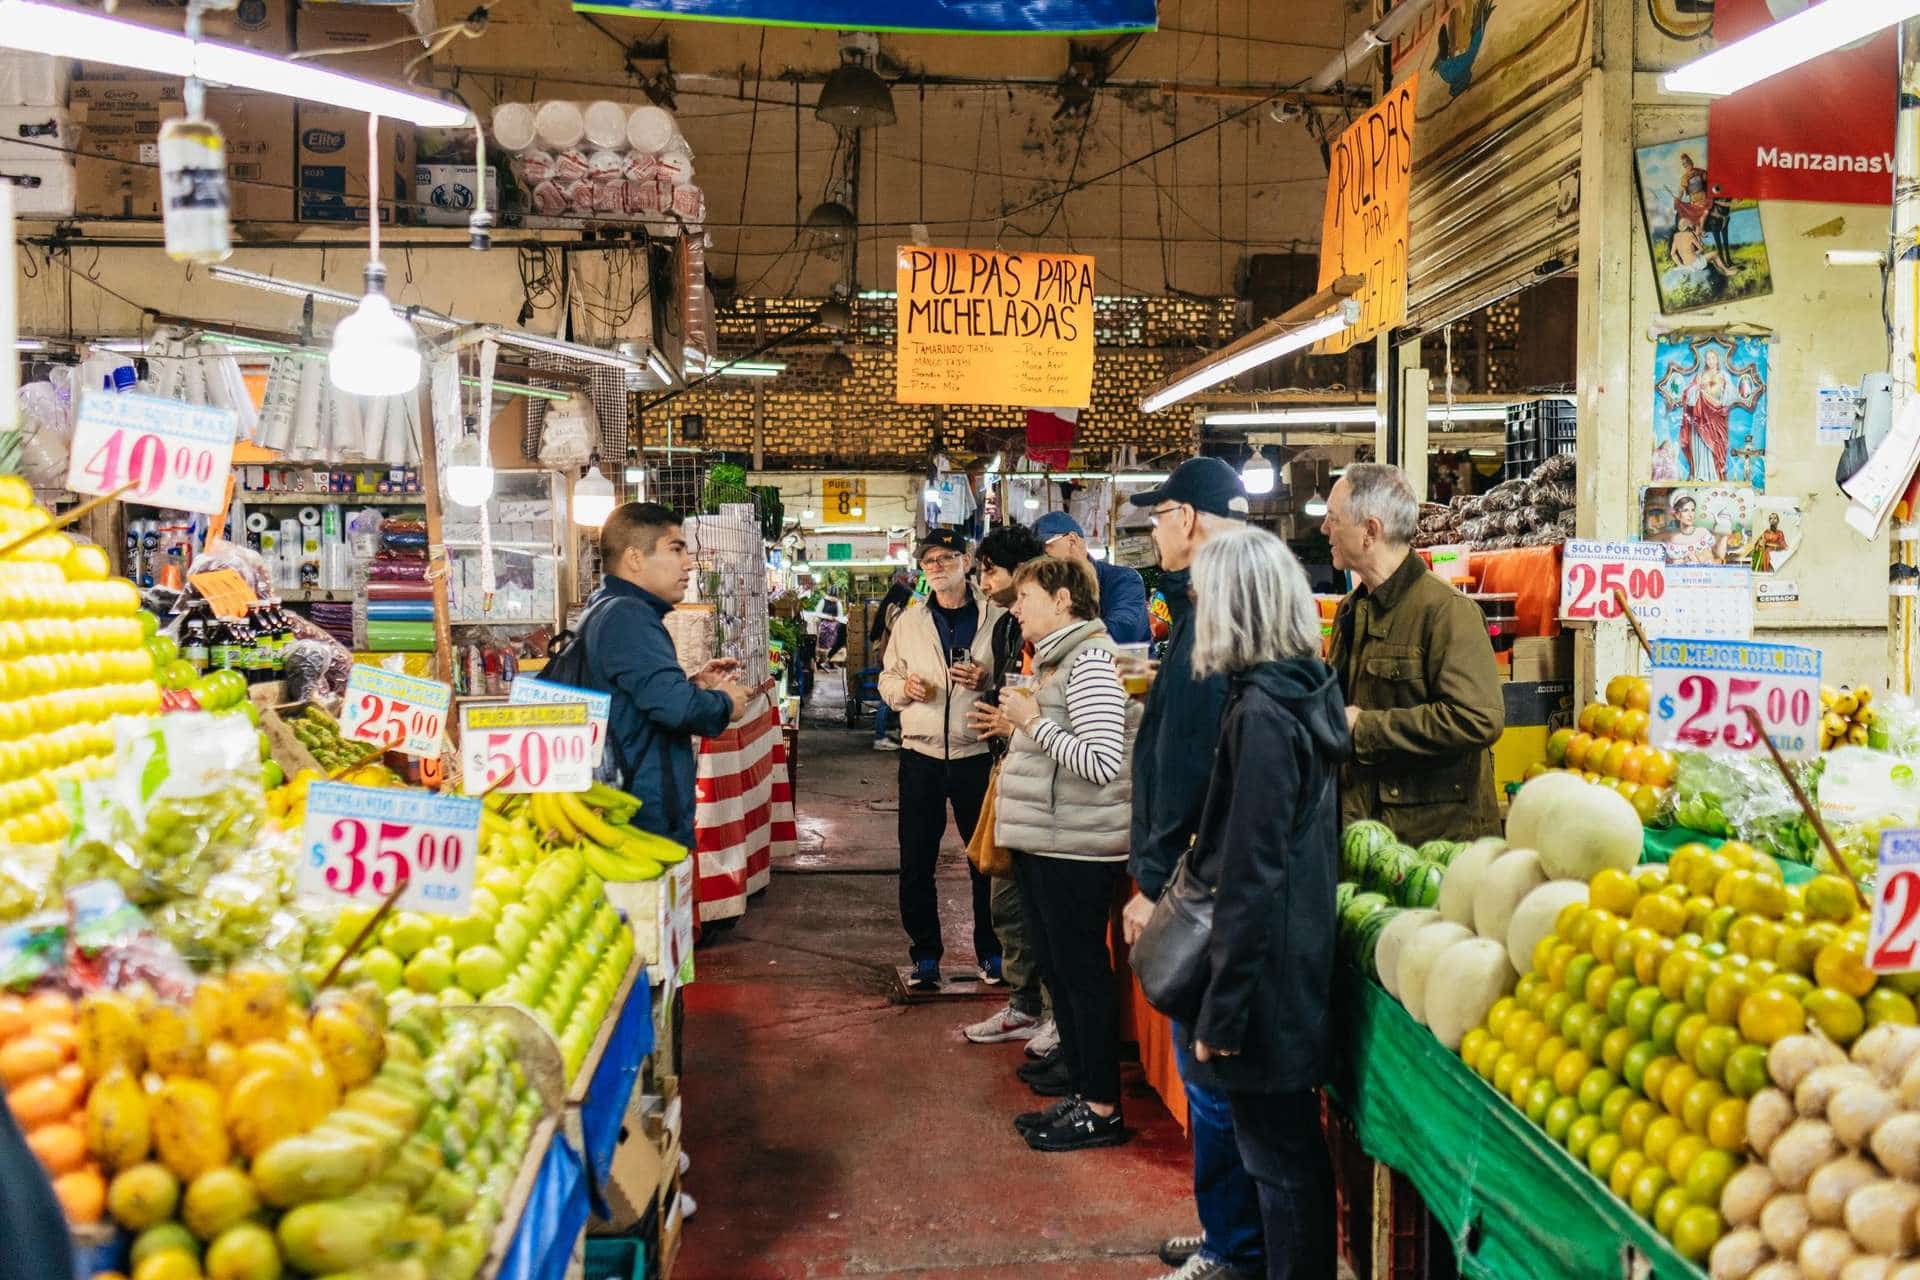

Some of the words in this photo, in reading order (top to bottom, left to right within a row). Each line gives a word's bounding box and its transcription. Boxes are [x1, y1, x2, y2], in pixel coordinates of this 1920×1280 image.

[307, 131, 342, 147] Elite
[1362, 200, 1391, 254] PARA
[911, 251, 1023, 298] PULPAS
[1035, 258, 1095, 306] PARA
[907, 298, 1078, 342] MICHELADAS
[838, 491, 849, 515] 8
[1572, 544, 1602, 554] SOLO
[1606, 545, 1630, 555] POR
[1634, 546, 1659, 556] HOY
[1660, 647, 1680, 661] LO
[1686, 648, 1741, 664] MEJOR
[1747, 650, 1777, 667] DEL
